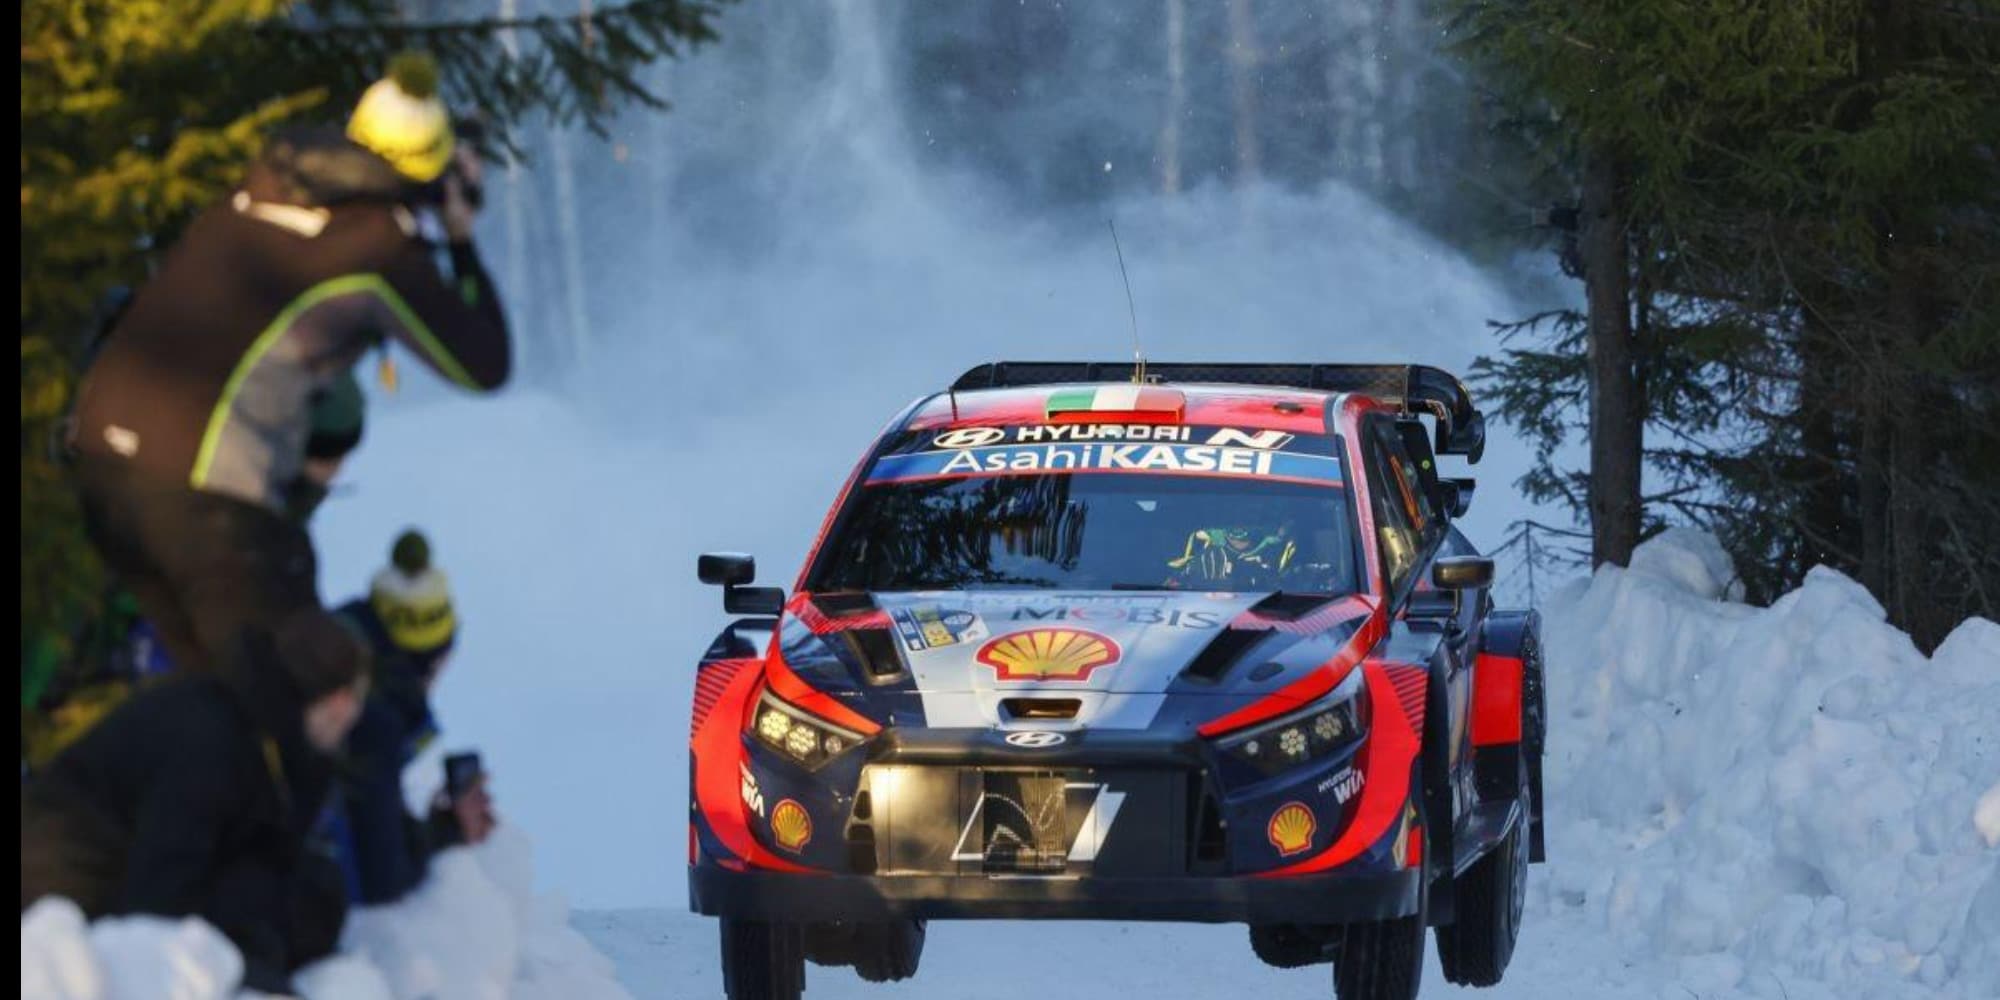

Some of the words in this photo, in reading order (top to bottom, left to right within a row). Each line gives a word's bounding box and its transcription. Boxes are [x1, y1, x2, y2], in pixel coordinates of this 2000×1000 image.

[1017, 425, 1190, 442] HYUNDAI
[1010, 605, 1220, 630] MOBIS
[1334, 768, 1365, 805] WIA
